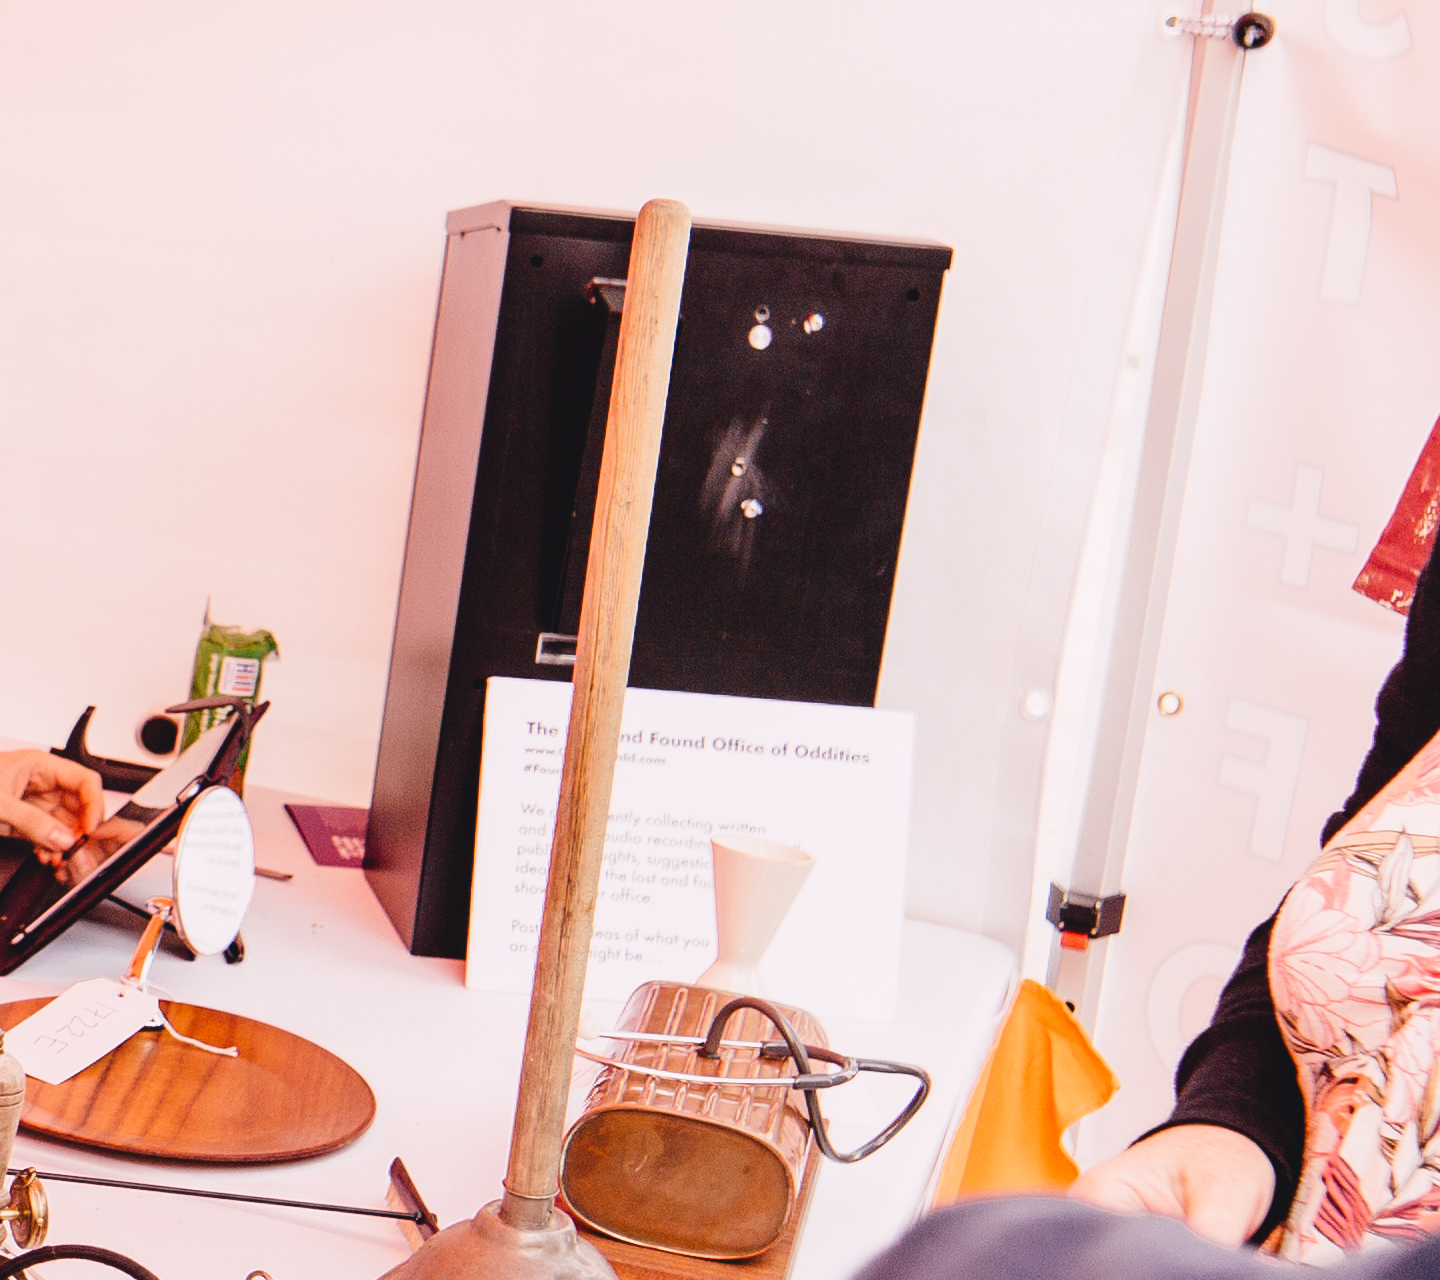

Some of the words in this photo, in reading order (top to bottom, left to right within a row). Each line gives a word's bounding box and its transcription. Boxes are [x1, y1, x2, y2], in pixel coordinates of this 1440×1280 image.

[526, 721, 558, 737] The
[649, 731, 706, 749] Found
[712, 737, 764, 754] Office
[771, 742, 789, 756] of
[795, 744, 870, 763] Oddities
[520, 802, 545, 816] We
[645, 812, 713, 834] collecting
[718, 822, 767, 834] written
[518, 823, 547, 836] and
[605, 869, 627, 882] the
[631, 869, 656, 884] lost
[661, 874, 689, 888] and
[508, 941, 528, 953] an
[624, 928, 639, 941] of
[643, 930, 680, 945] what
[683, 936, 710, 950] you
